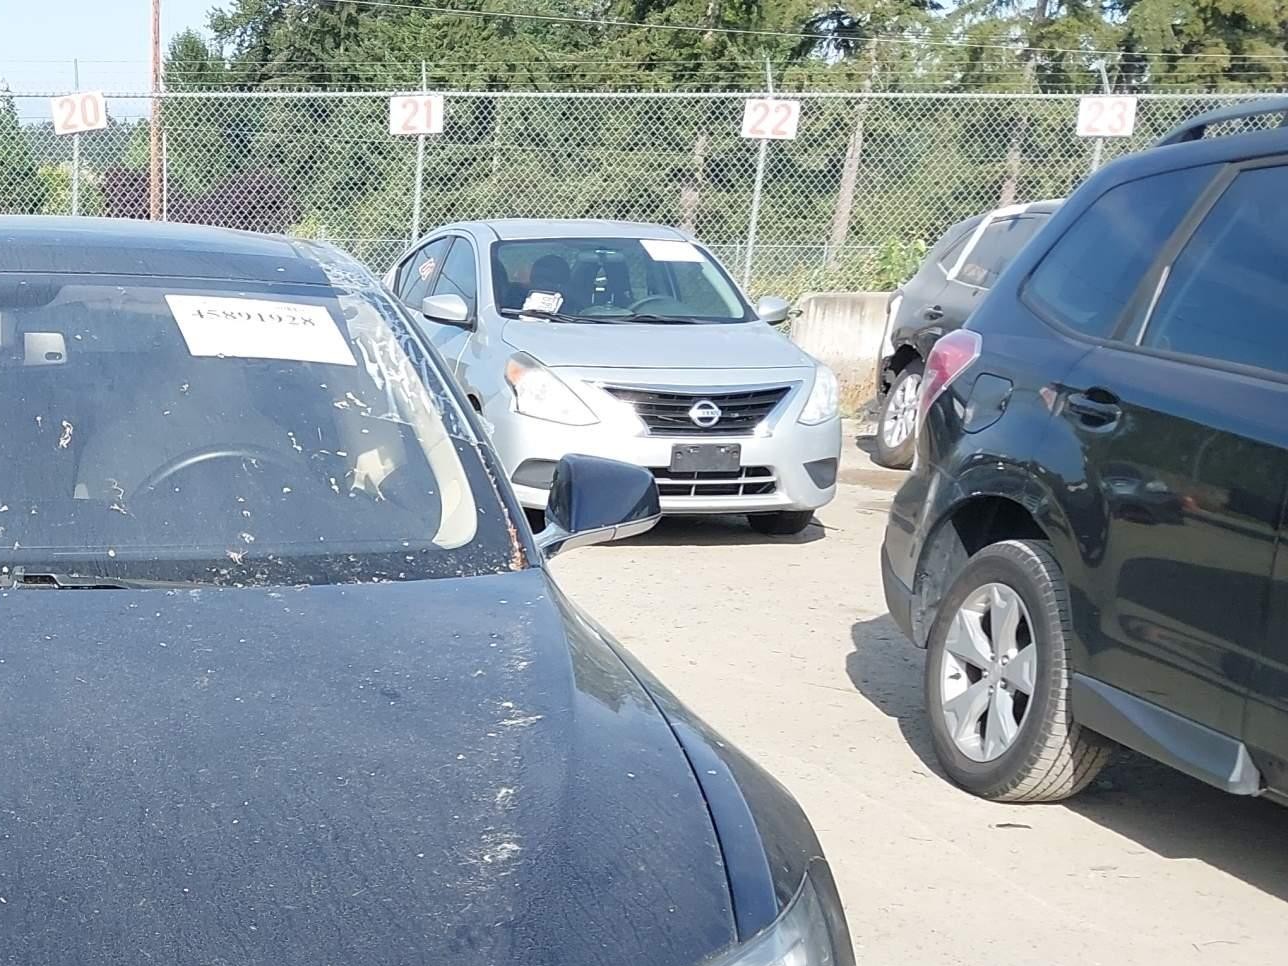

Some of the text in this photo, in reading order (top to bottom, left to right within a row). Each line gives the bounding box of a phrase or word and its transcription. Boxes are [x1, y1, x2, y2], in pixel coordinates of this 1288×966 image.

[59, 94, 100, 131] 20
[400, 98, 433, 132] 21
[749, 102, 792, 136] 22
[1085, 100, 1128, 134] 23
[191, 308, 316, 327] 45891928
